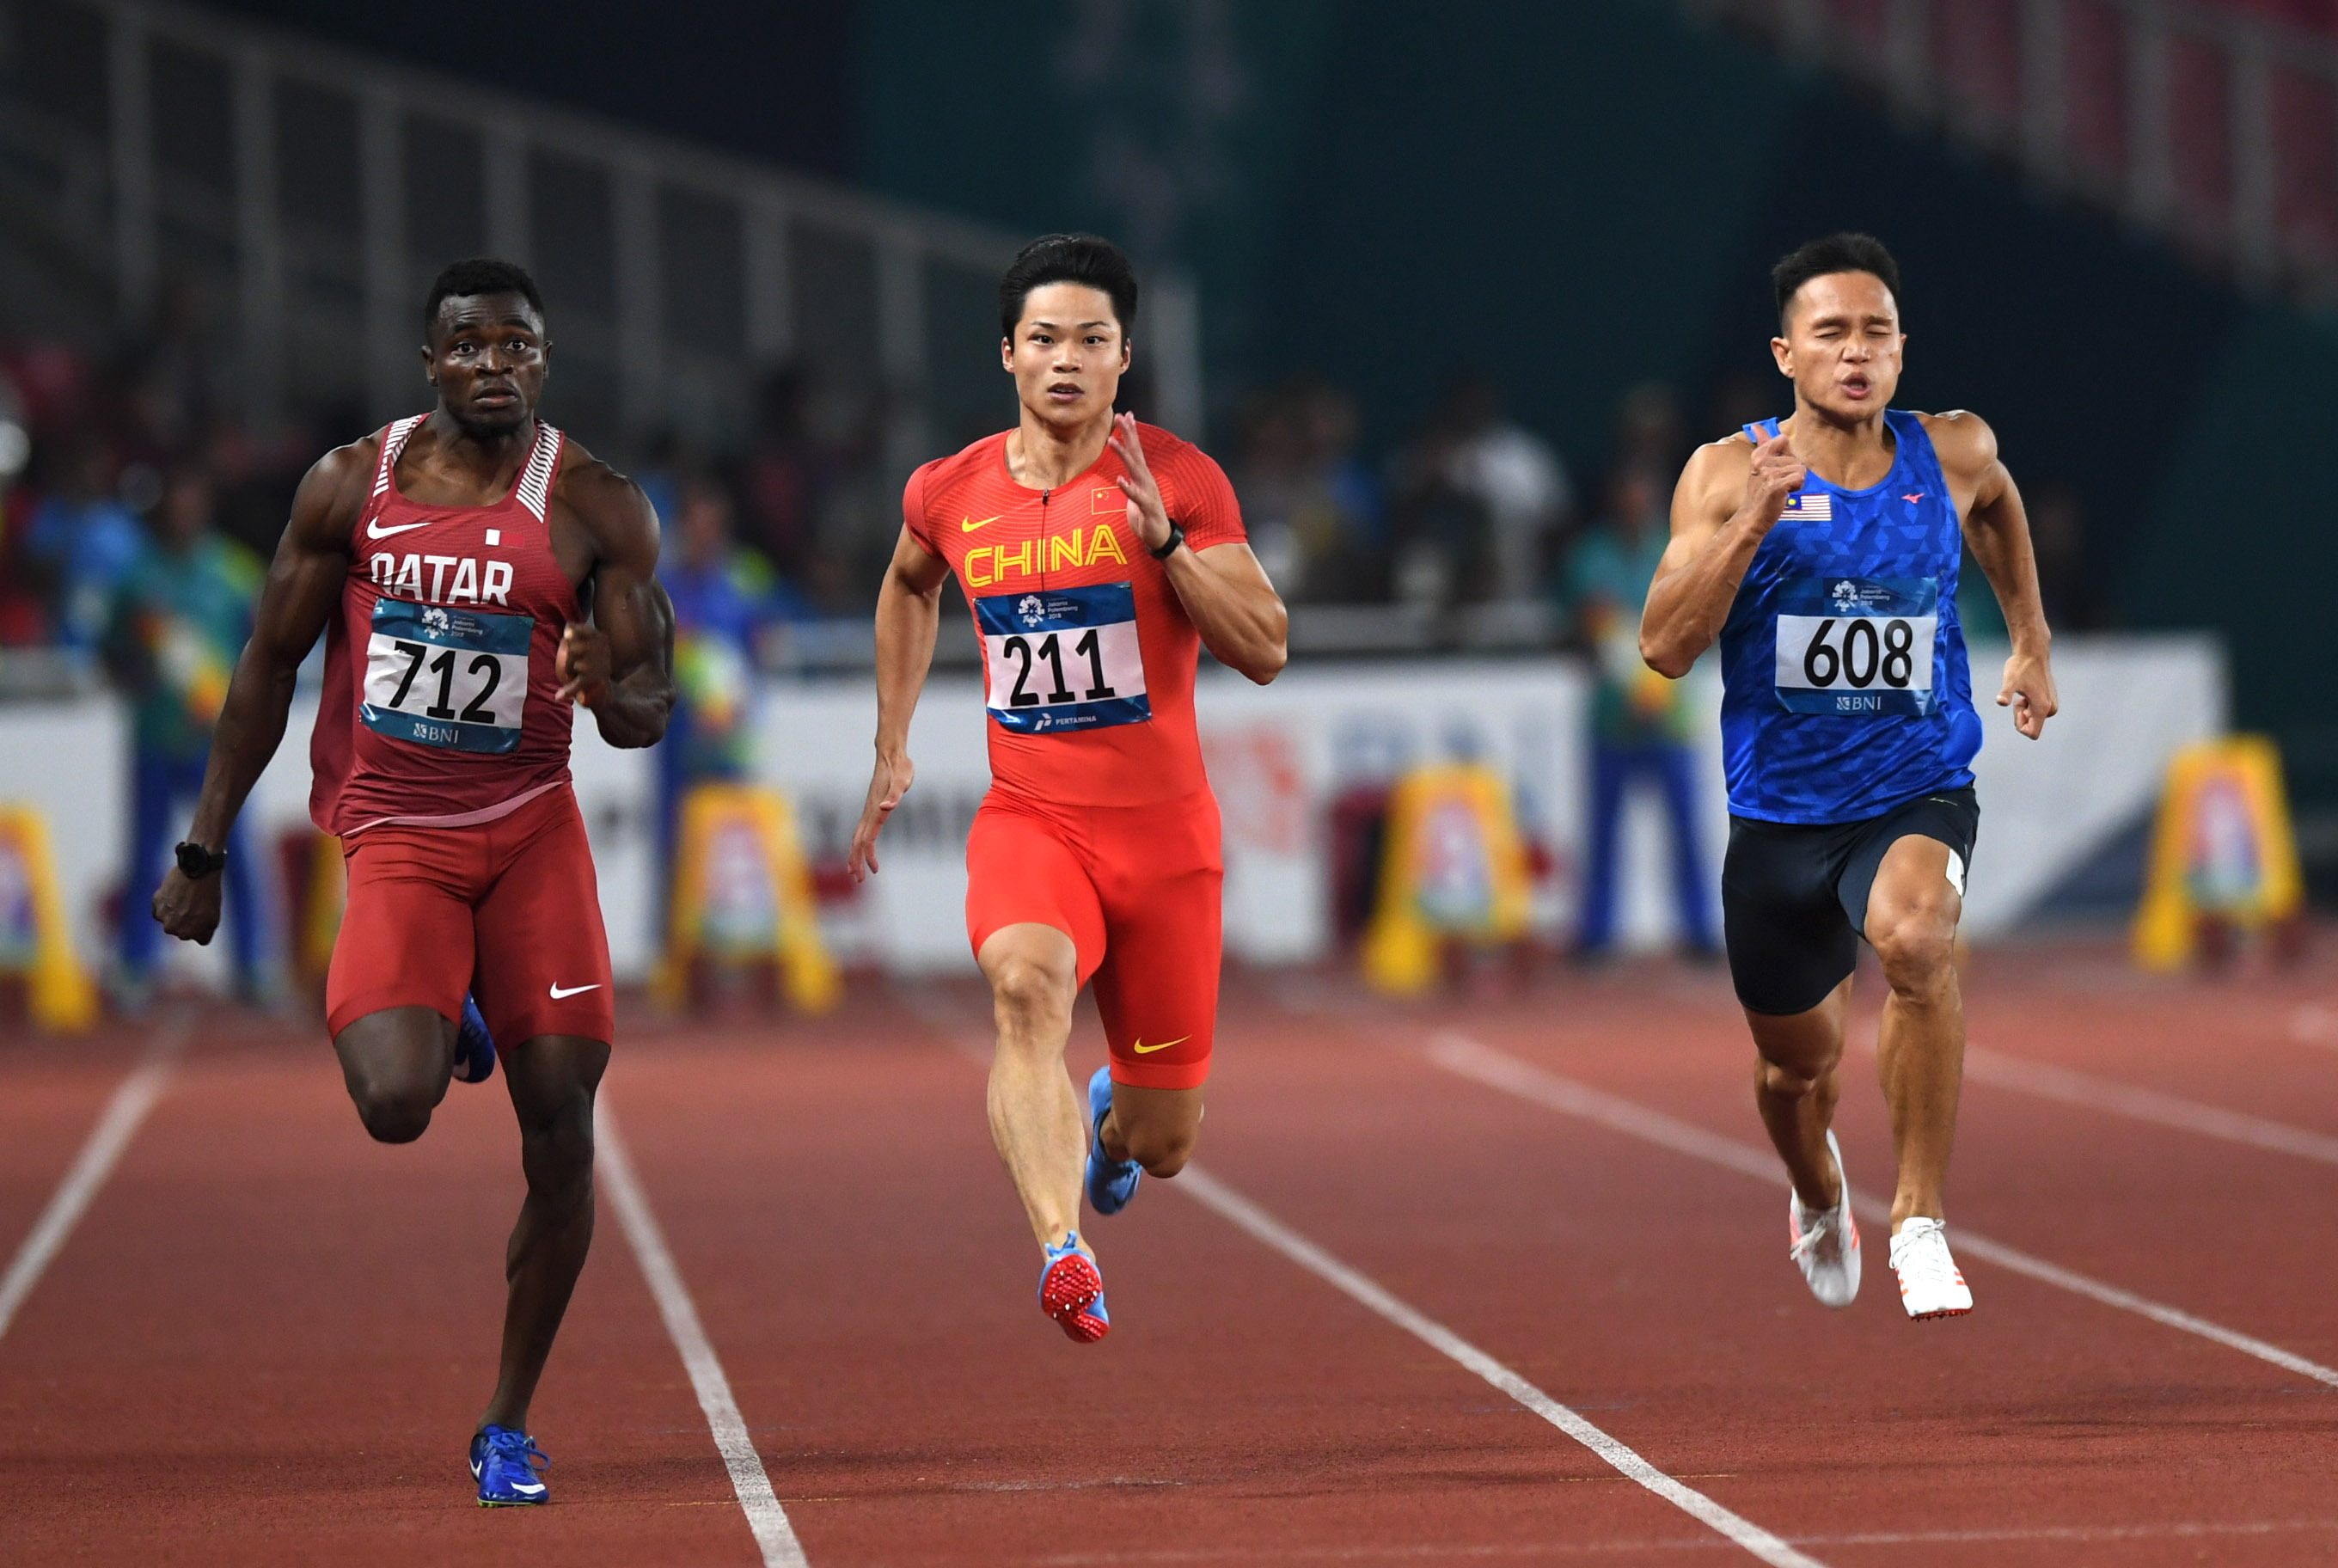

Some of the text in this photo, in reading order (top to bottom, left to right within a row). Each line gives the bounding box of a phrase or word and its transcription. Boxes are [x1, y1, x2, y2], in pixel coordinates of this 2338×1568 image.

[370, 553, 514, 607] QATAR
[964, 525, 1128, 587] CHINA
[389, 640, 502, 725] 712
[1003, 628, 1116, 707] 211
[1803, 619, 1913, 689] 608
[1056, 715, 1097, 726] PERTAMINA
[1852, 696, 1881, 711] BNI
[428, 726, 459, 744] BNI
